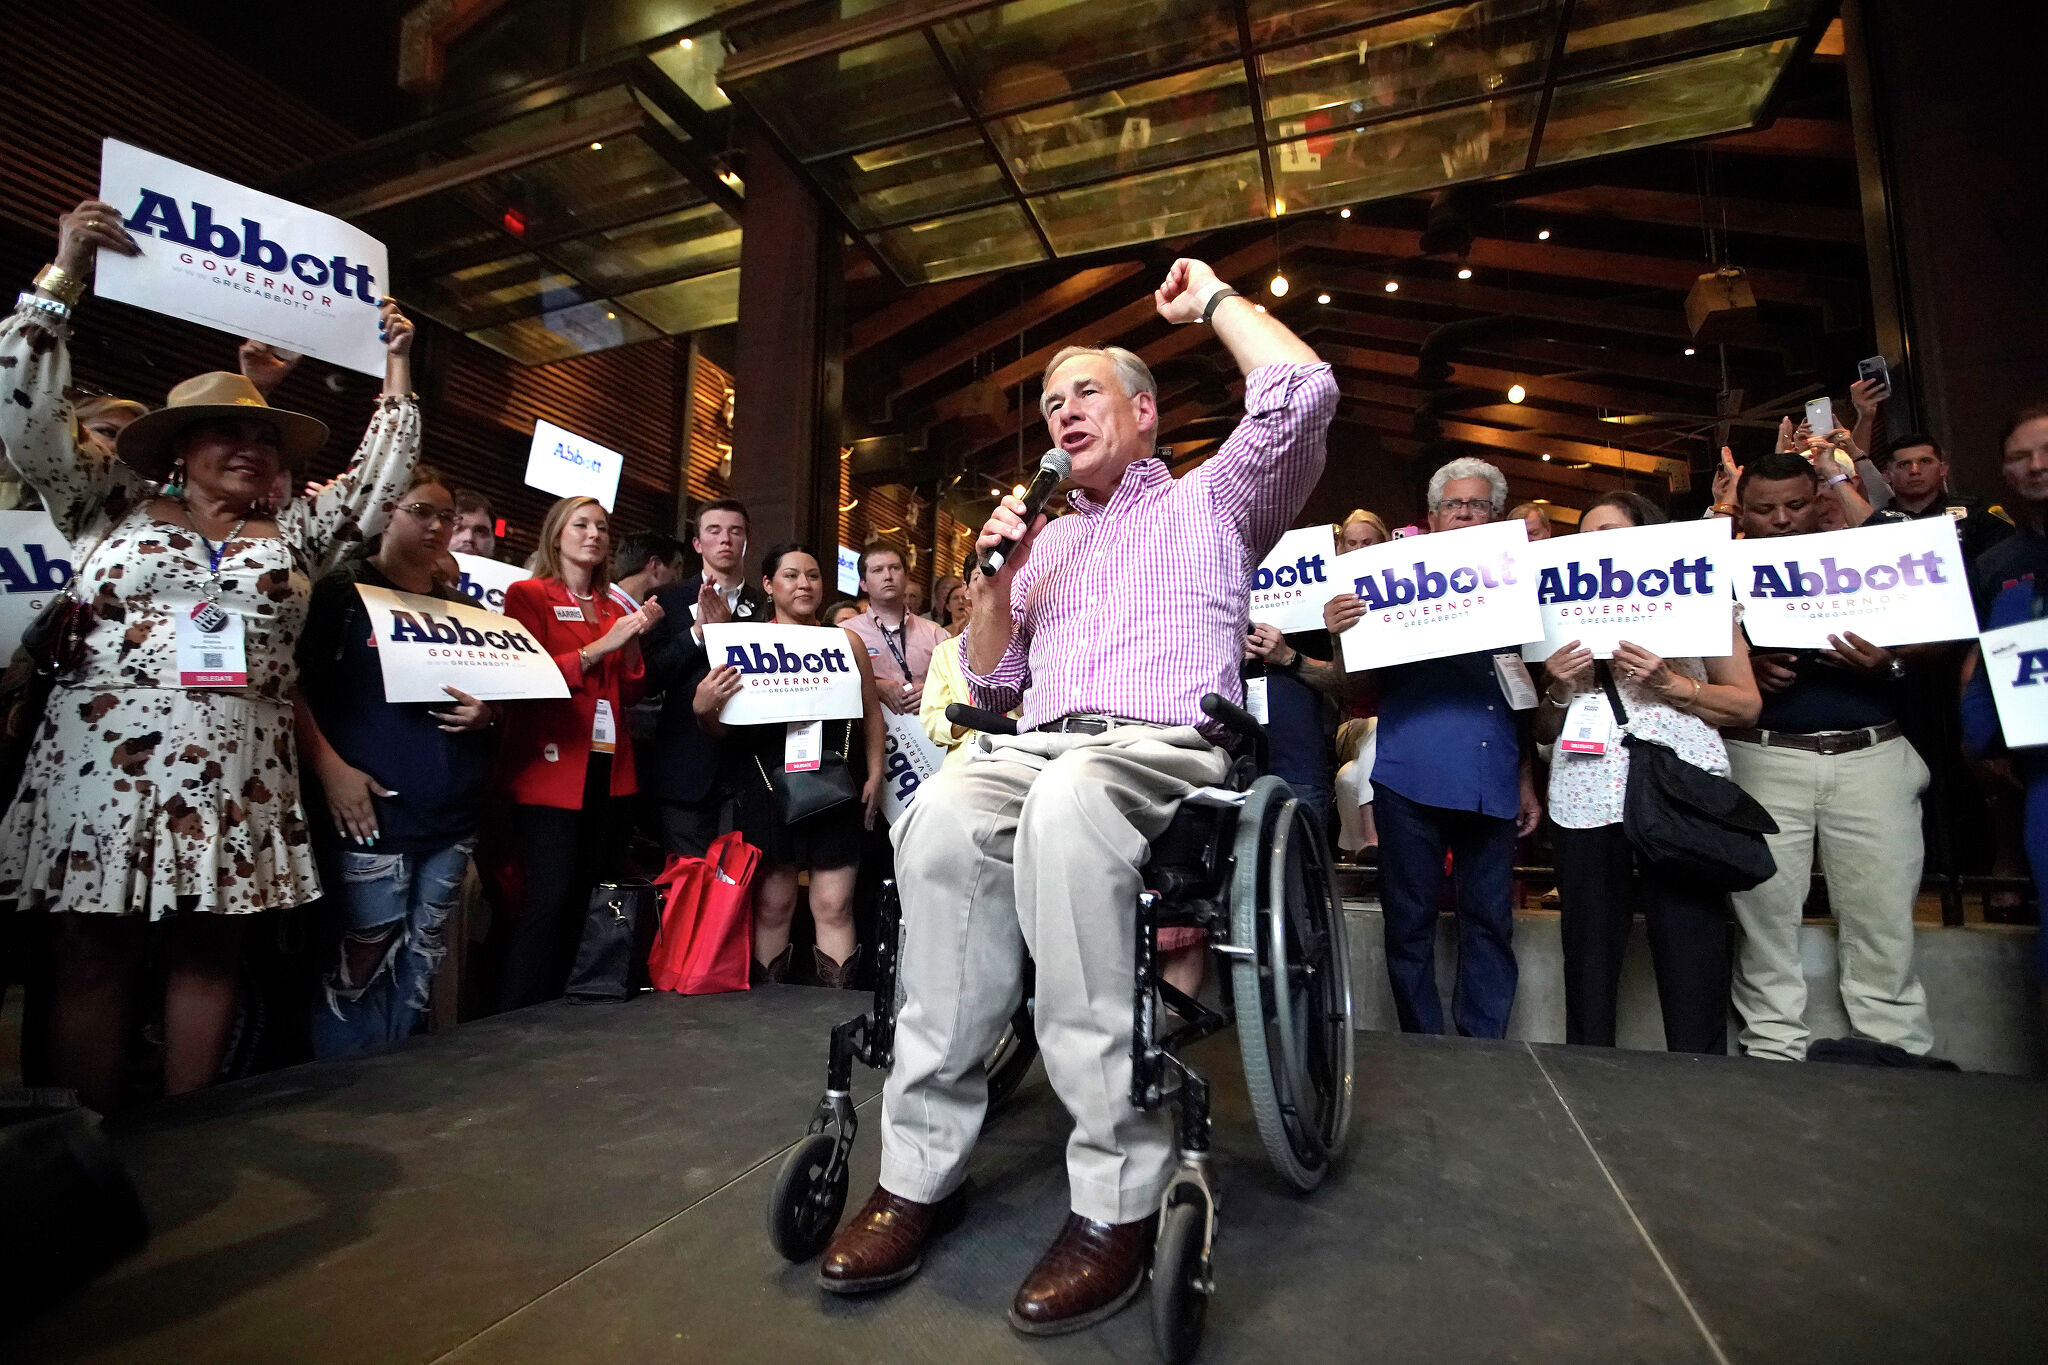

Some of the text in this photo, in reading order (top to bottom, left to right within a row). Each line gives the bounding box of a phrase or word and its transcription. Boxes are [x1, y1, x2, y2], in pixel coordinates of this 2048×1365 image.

[123, 187, 376, 304] Abbott
[180, 253, 332, 307] GOVERNOR
[553, 442, 601, 473] Abbott
[1251, 554, 1327, 591] bott
[1354, 551, 1518, 611] Abbott
[1538, 556, 1715, 604] Abbott
[1749, 550, 1948, 598] Abbott
[1254, 589, 1302, 602] ERNOR
[1383, 596, 1485, 623] GOVERNOR
[1561, 602, 1672, 617] GOVERNOR
[201, 608, 226, 630] IKE
[556, 609, 582, 619] HARRIS
[390, 610, 539, 654] Abbott
[428, 648, 520, 661] GOVERNOR
[725, 643, 849, 674] Abbott
[751, 676, 829, 687] GOVERNOR
[896, 726, 930, 780] OVERNOR
